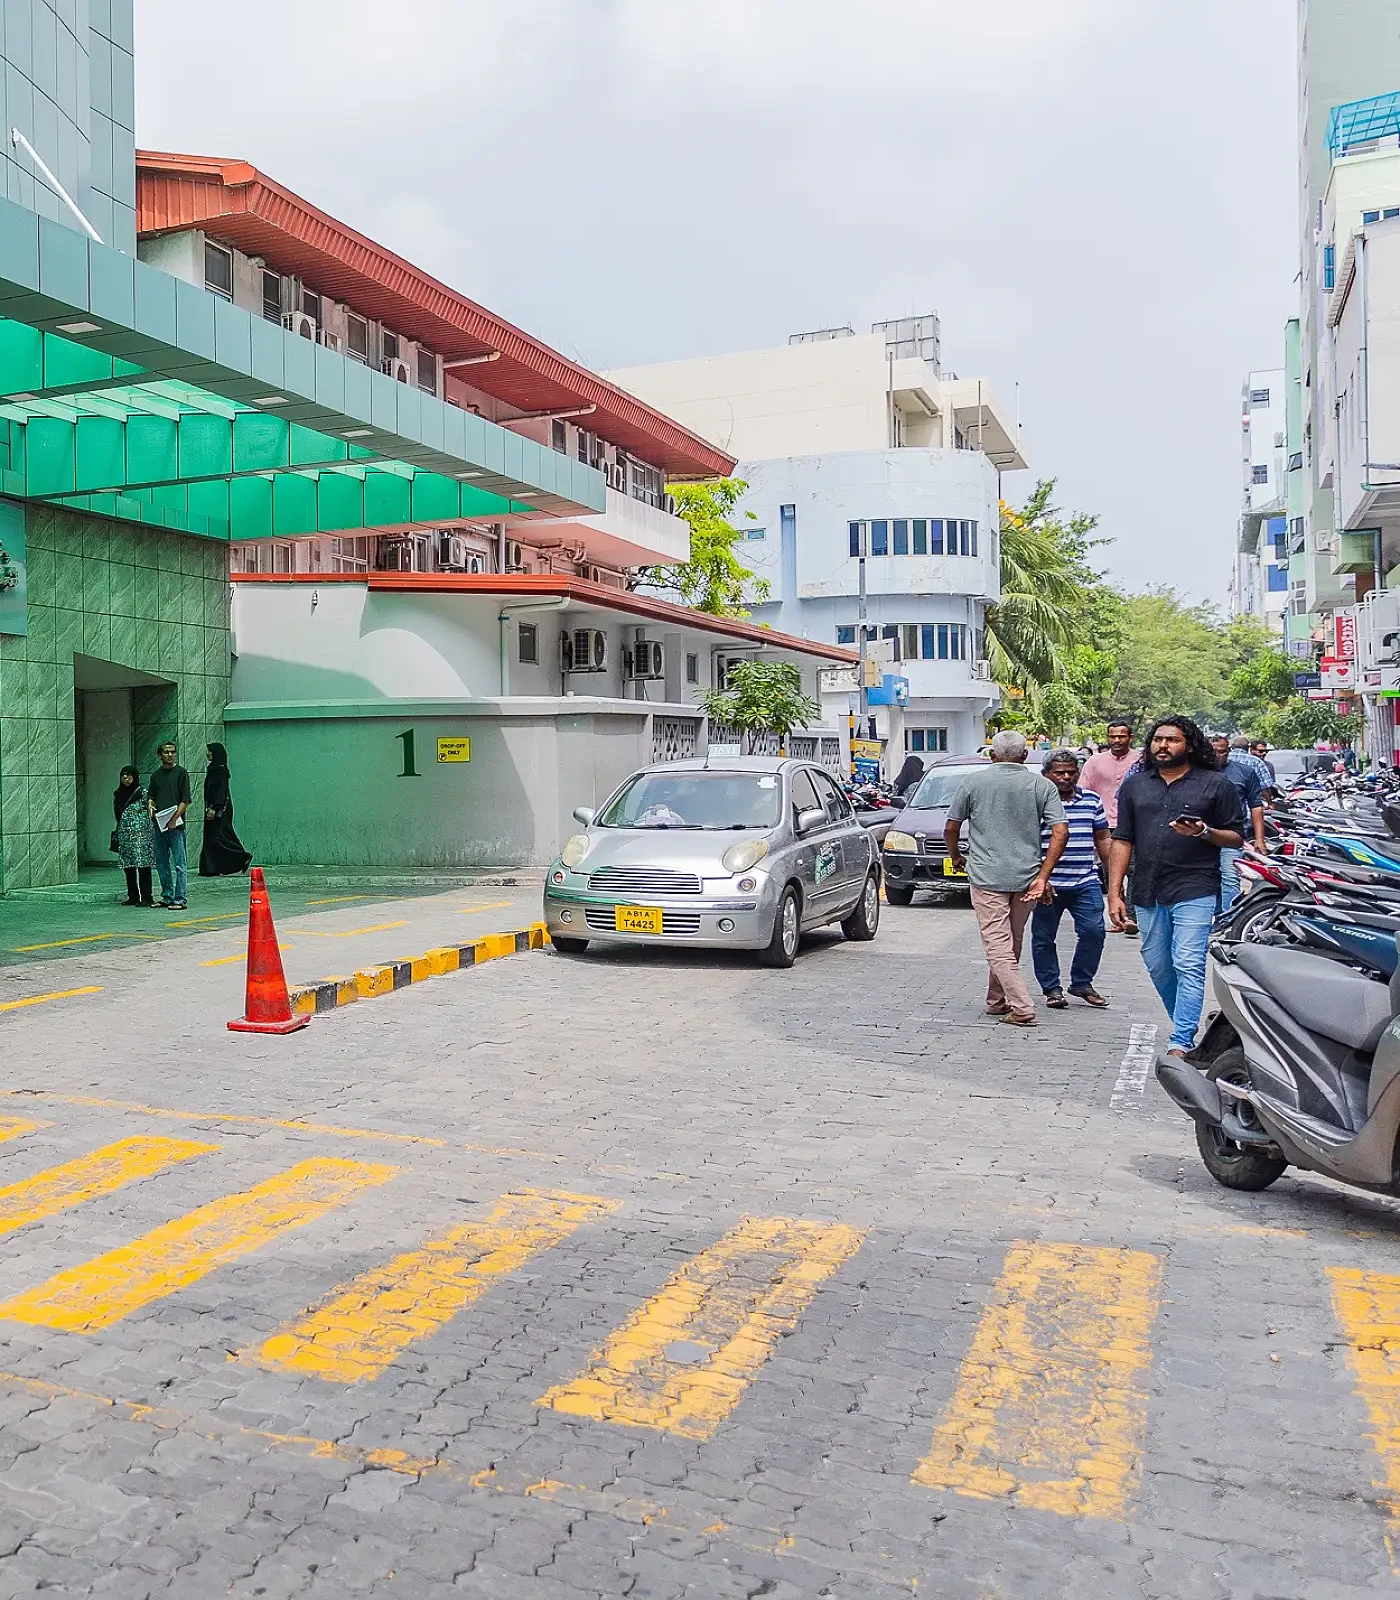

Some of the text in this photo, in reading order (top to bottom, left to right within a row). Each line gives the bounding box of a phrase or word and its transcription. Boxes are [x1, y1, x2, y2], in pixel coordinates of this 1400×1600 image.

[395, 728, 422, 777] 1
[623, 919, 655, 930] T4425
[1332, 925, 1377, 941] VISION
